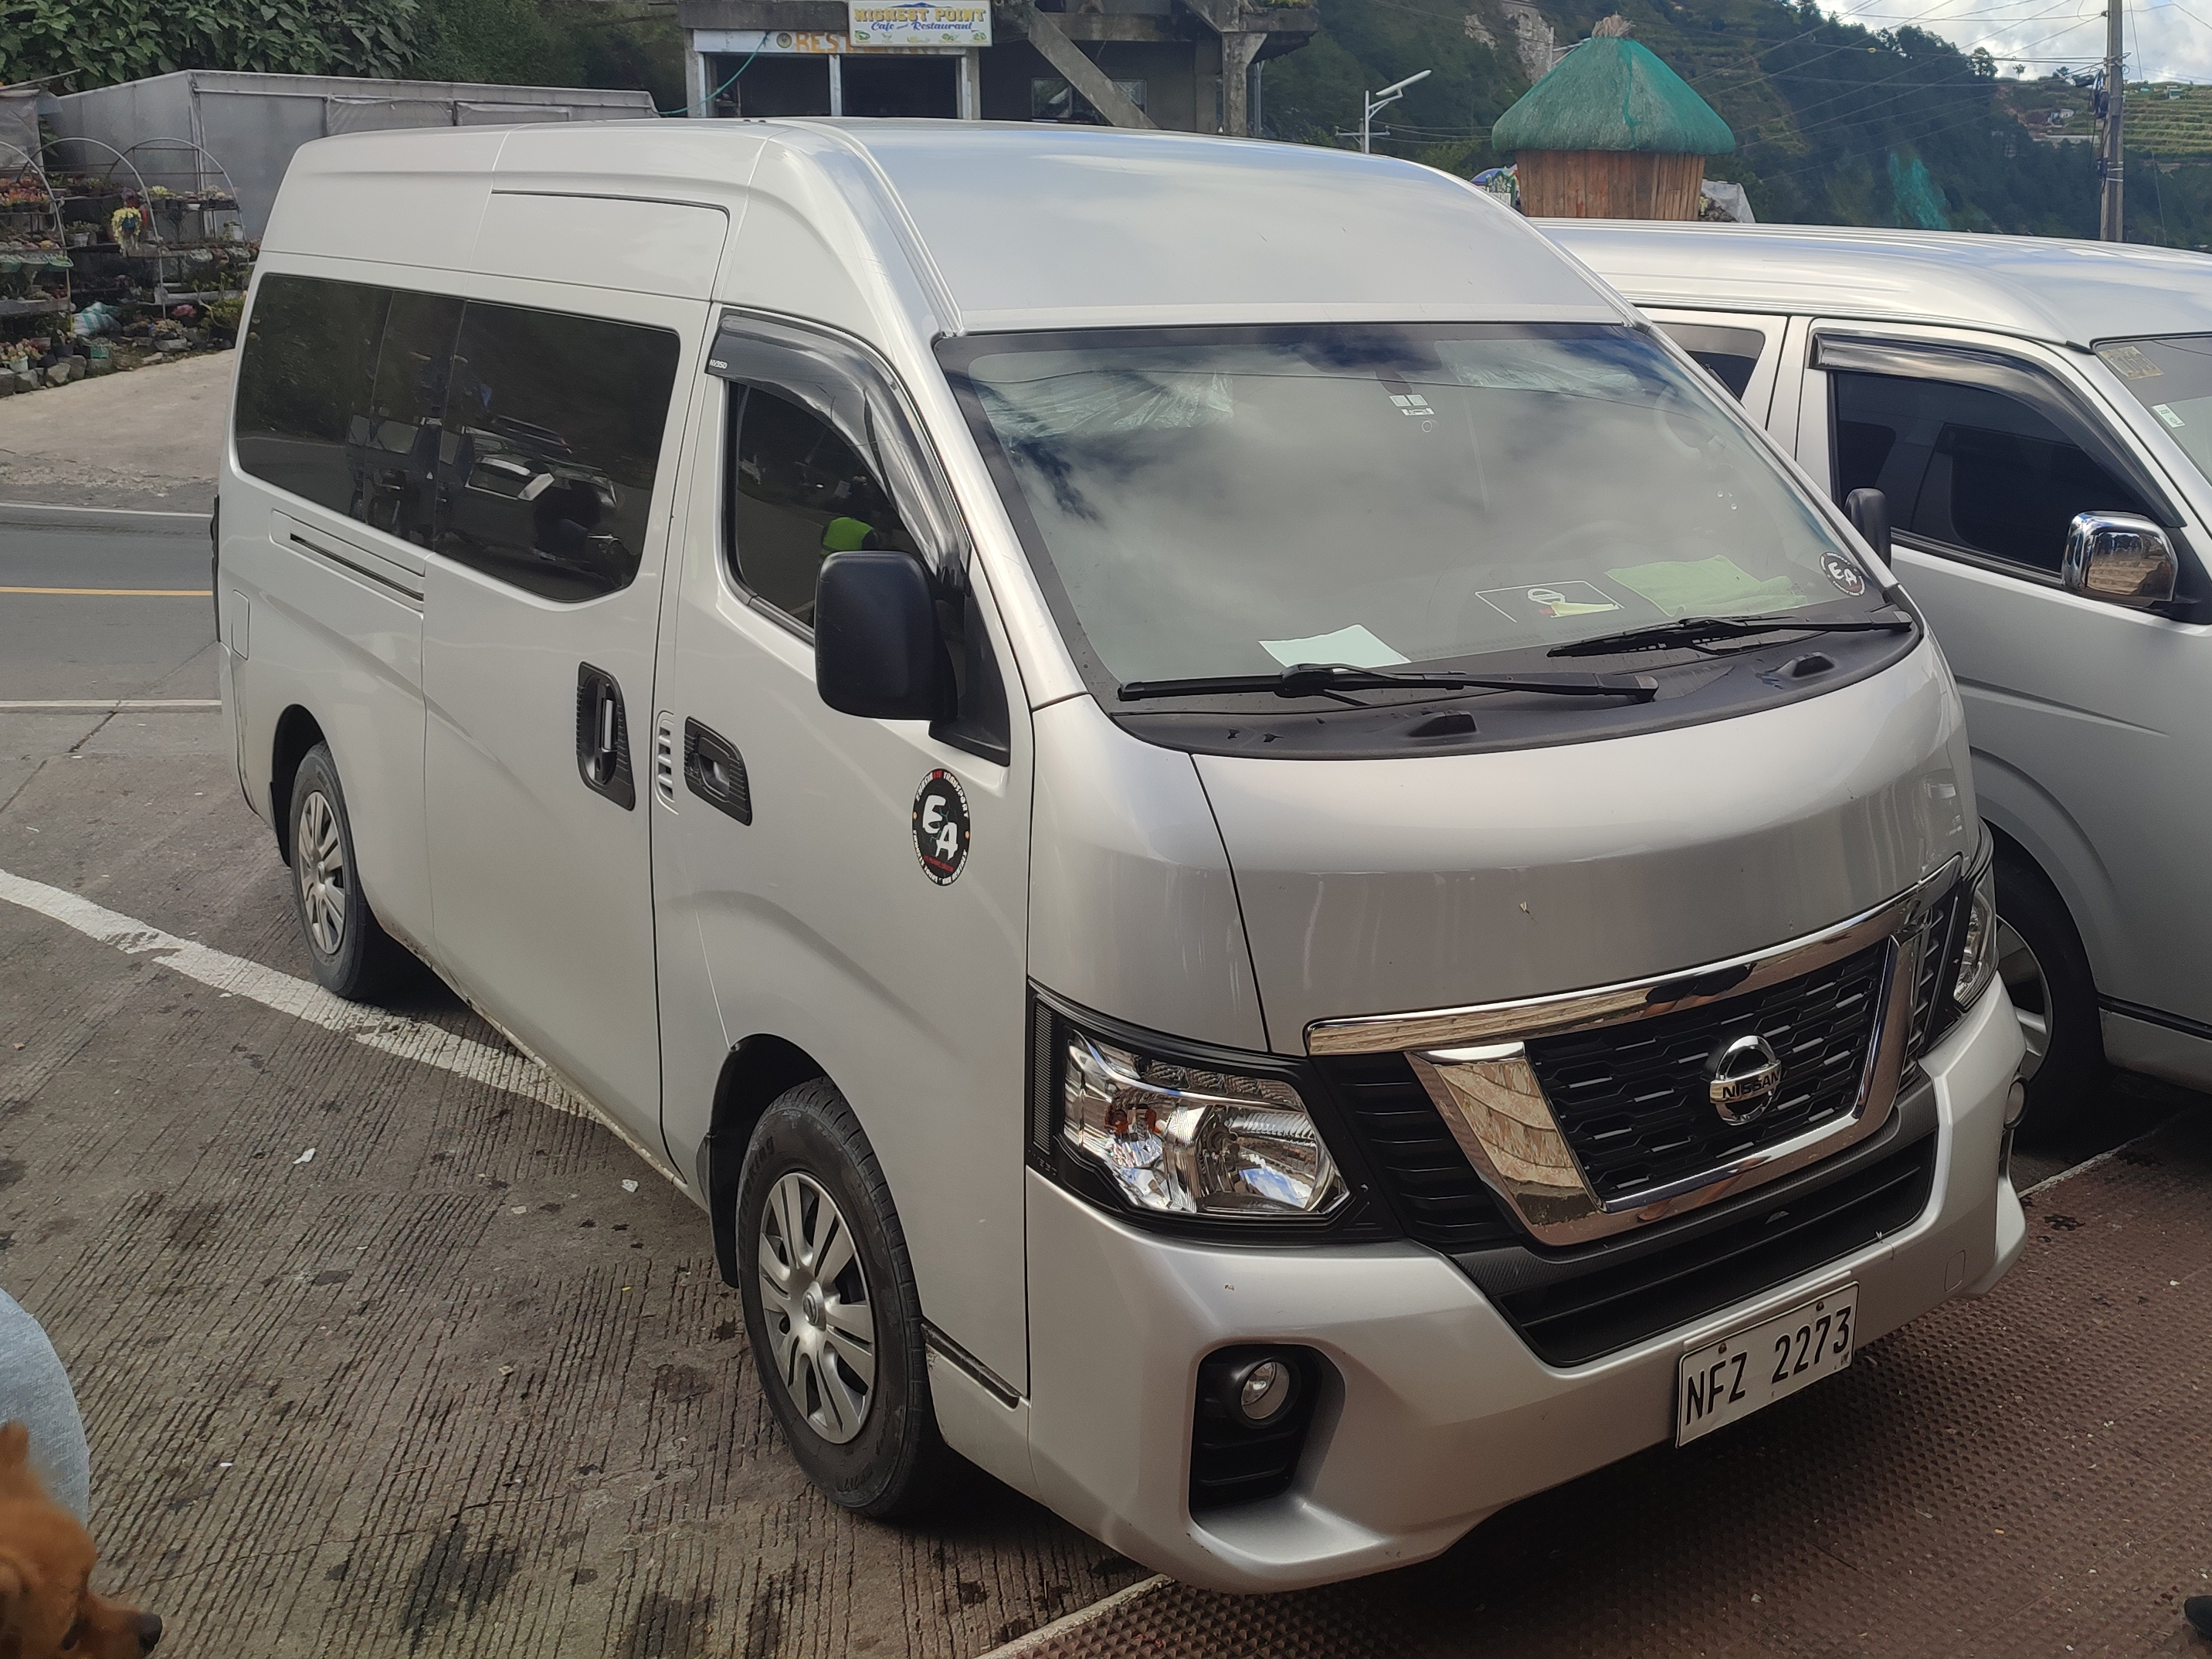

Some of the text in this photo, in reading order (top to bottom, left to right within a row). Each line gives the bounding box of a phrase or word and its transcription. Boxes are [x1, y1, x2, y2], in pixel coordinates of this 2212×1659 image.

[854, 8, 986, 22] HIGHEST POINT
[871, 22, 895, 31] Cafe
[911, 22, 973, 31] Restaurant
[1827, 561, 1857, 586] EA
[922, 794, 958, 861] EA
[1722, 1070, 1780, 1098] NISSAN
[1685, 1305, 1852, 1426] NFZ 2273
